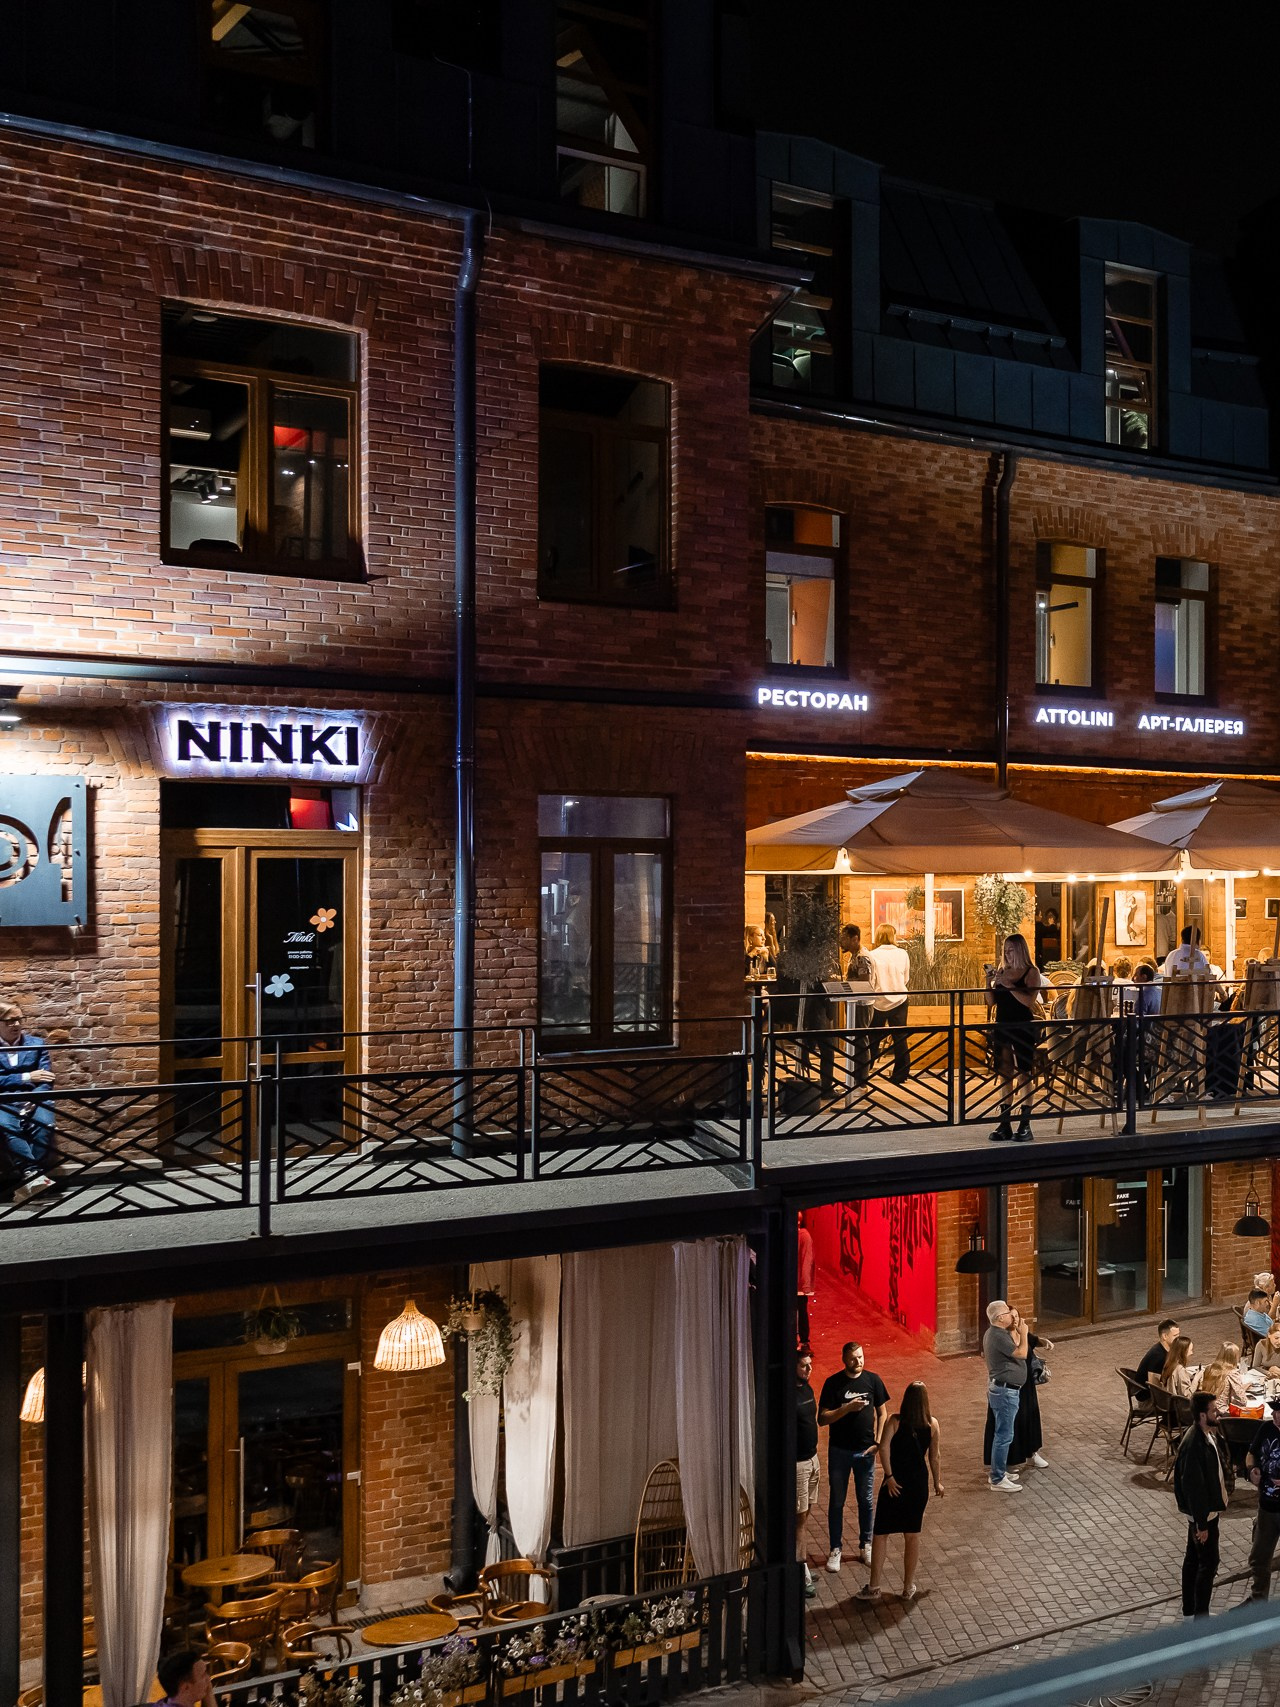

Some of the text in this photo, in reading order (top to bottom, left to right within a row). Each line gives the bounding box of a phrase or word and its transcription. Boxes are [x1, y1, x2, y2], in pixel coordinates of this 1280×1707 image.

[758, 687, 868, 711] РЕСТОРАН
[1035, 707, 1114, 727] ATTOLINI
[1138, 714, 1244, 735] АРТ-ГАЛЕРЕЯ
[177, 719, 359, 766] NINKI
